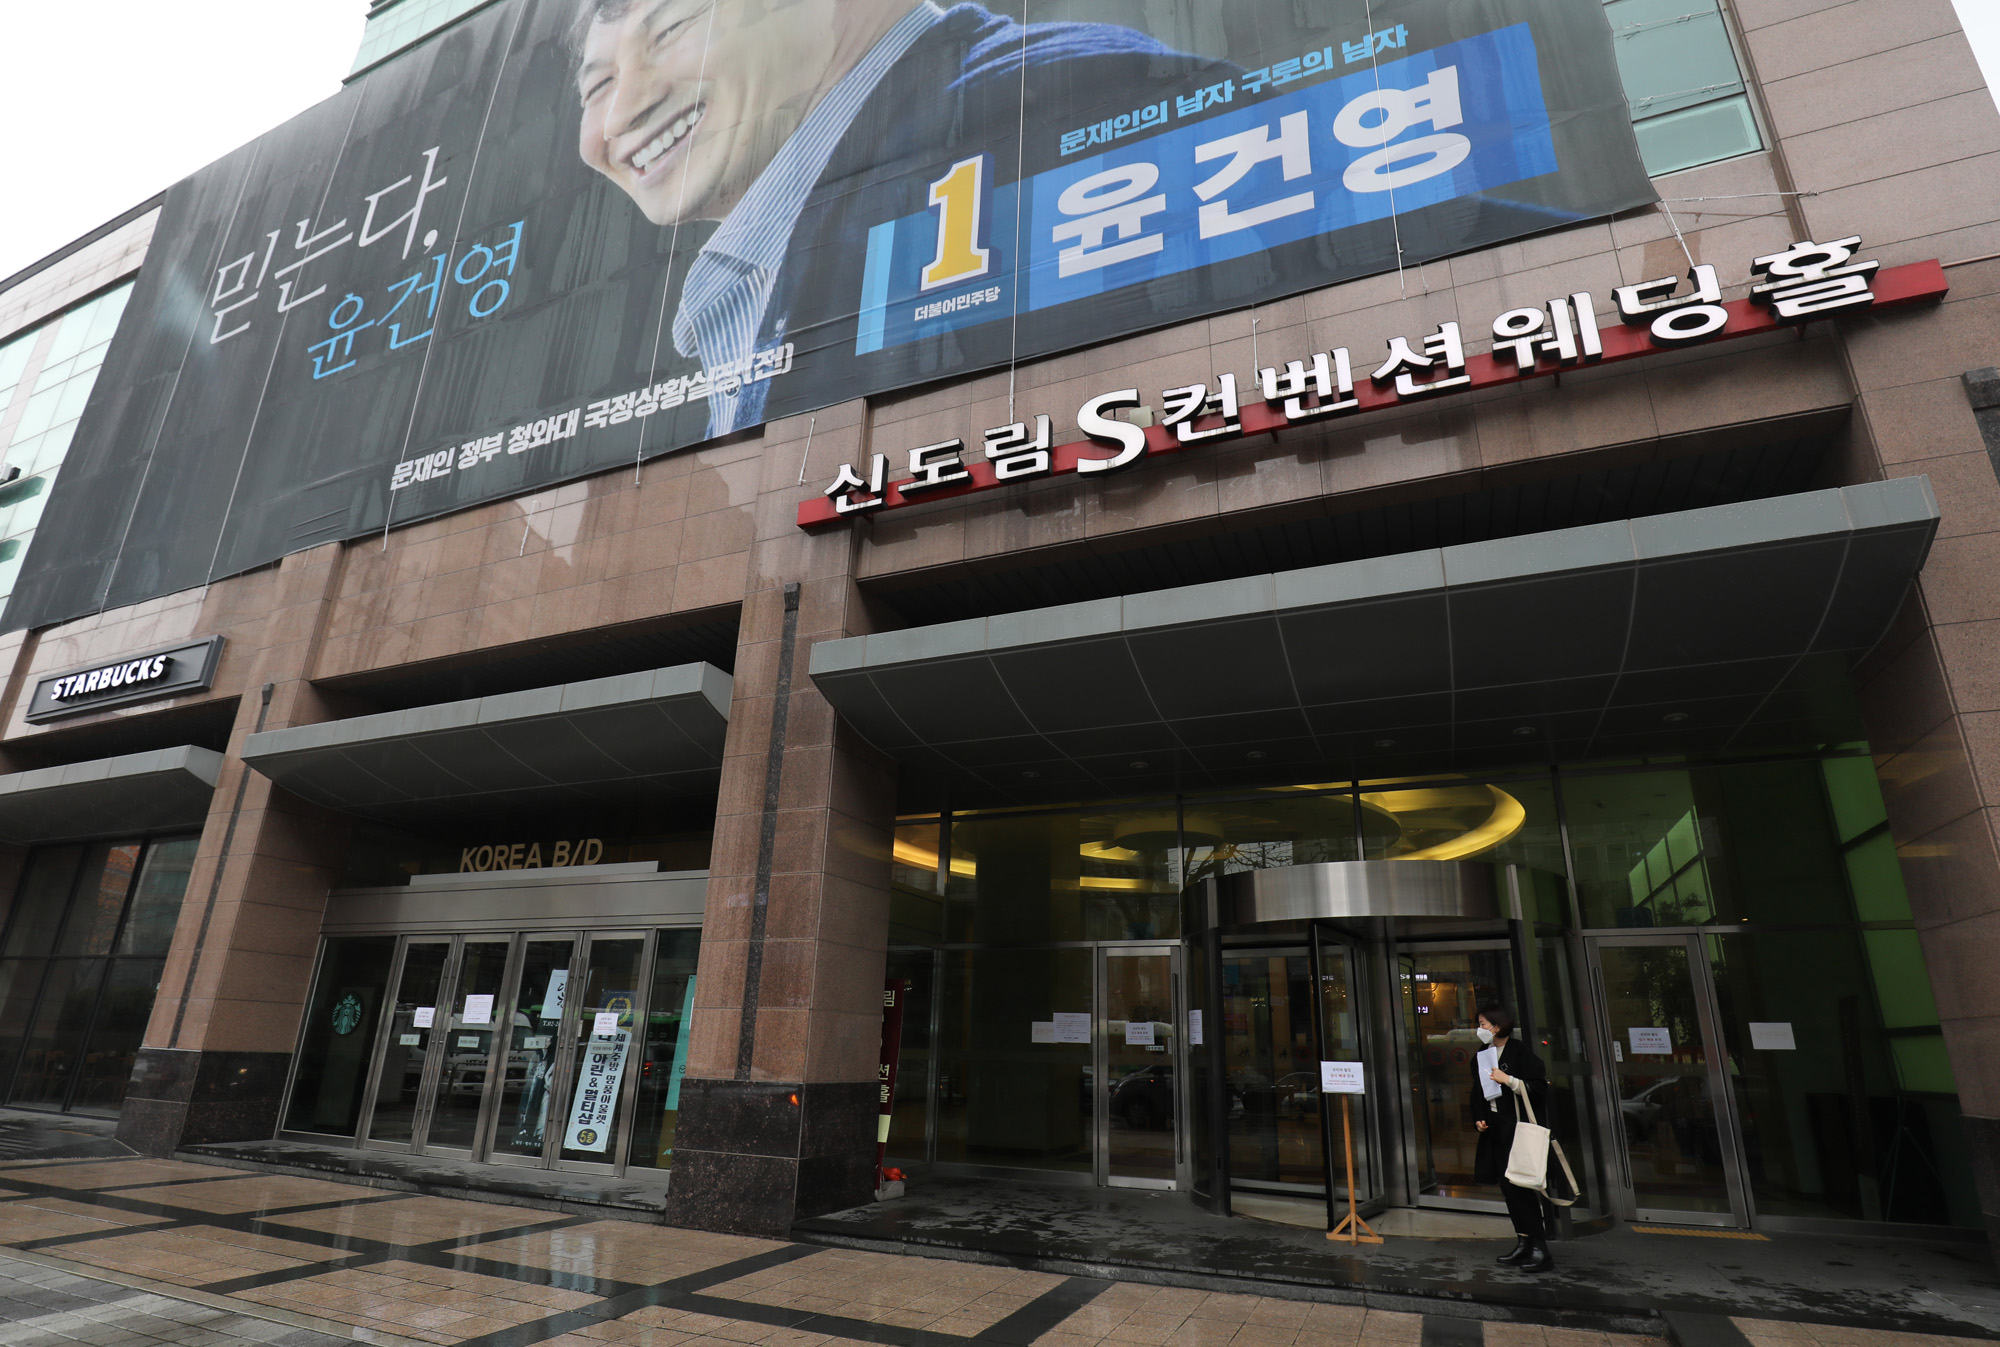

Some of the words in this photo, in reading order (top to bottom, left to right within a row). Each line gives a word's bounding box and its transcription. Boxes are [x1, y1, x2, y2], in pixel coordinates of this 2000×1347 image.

[1059, 93, 1169, 157] 문재인의
[1176, 79, 1235, 119] 남자
[1240, 45, 1333, 96] 구로의
[1343, 23, 1408, 66] 남자
[919, 152, 992, 292] 1
[1052, 65, 1471, 280] 윤건영
[209, 146, 447, 345] 믿는다,
[307, 221, 525, 380] 윤건영
[913, 286, 1001, 322] 더불어민주당
[390, 447, 456, 491] 문재인
[457, 432, 504, 470] 정부
[507, 408, 581, 455] 청와대
[823, 413, 1053, 515] 신도림
[51, 655, 167, 699] STARBUCKS
[459, 842, 542, 873] KOREA
[552, 838, 604, 867] B/D
[578, 1130, 595, 1145] 5층
